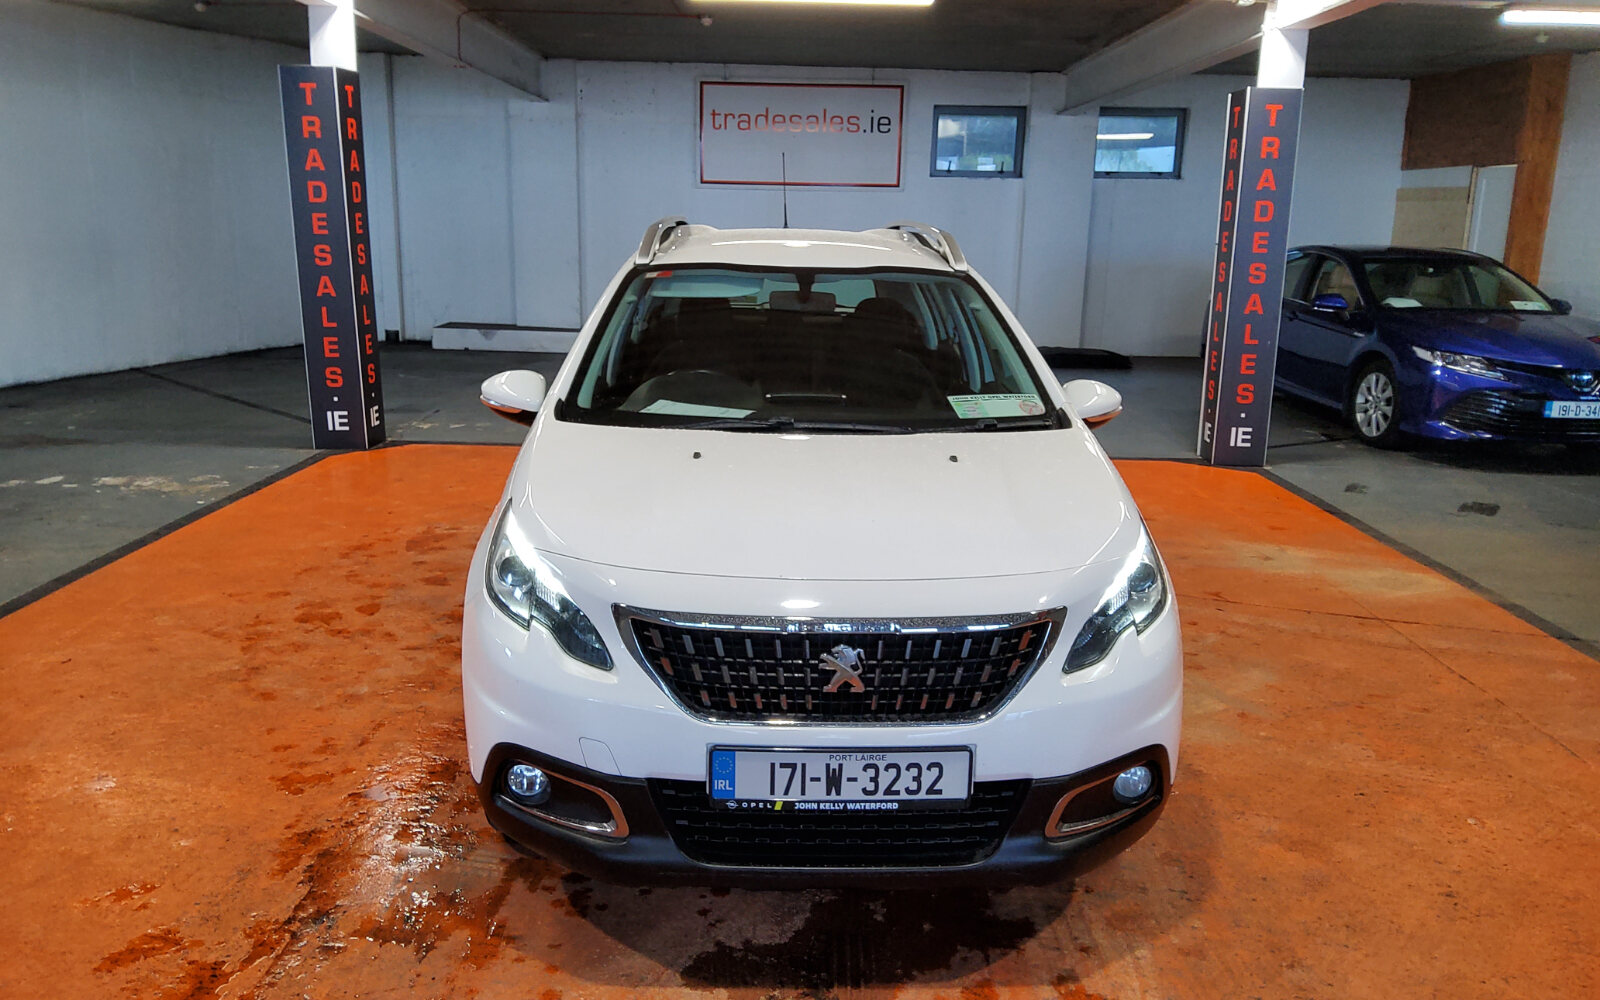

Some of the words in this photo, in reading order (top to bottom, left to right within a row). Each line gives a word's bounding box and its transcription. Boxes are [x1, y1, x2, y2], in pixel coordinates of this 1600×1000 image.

[710, 107, 892, 134] tradesales.ie
[829, 754, 853, 762] PORT
[714, 779, 734, 791] IRL
[769, 762, 944, 796] 171-W-3232
[794, 802, 818, 810] JOHN
[819, 802, 845, 810] KELLY
[846, 802, 899, 810] WATERFORD
